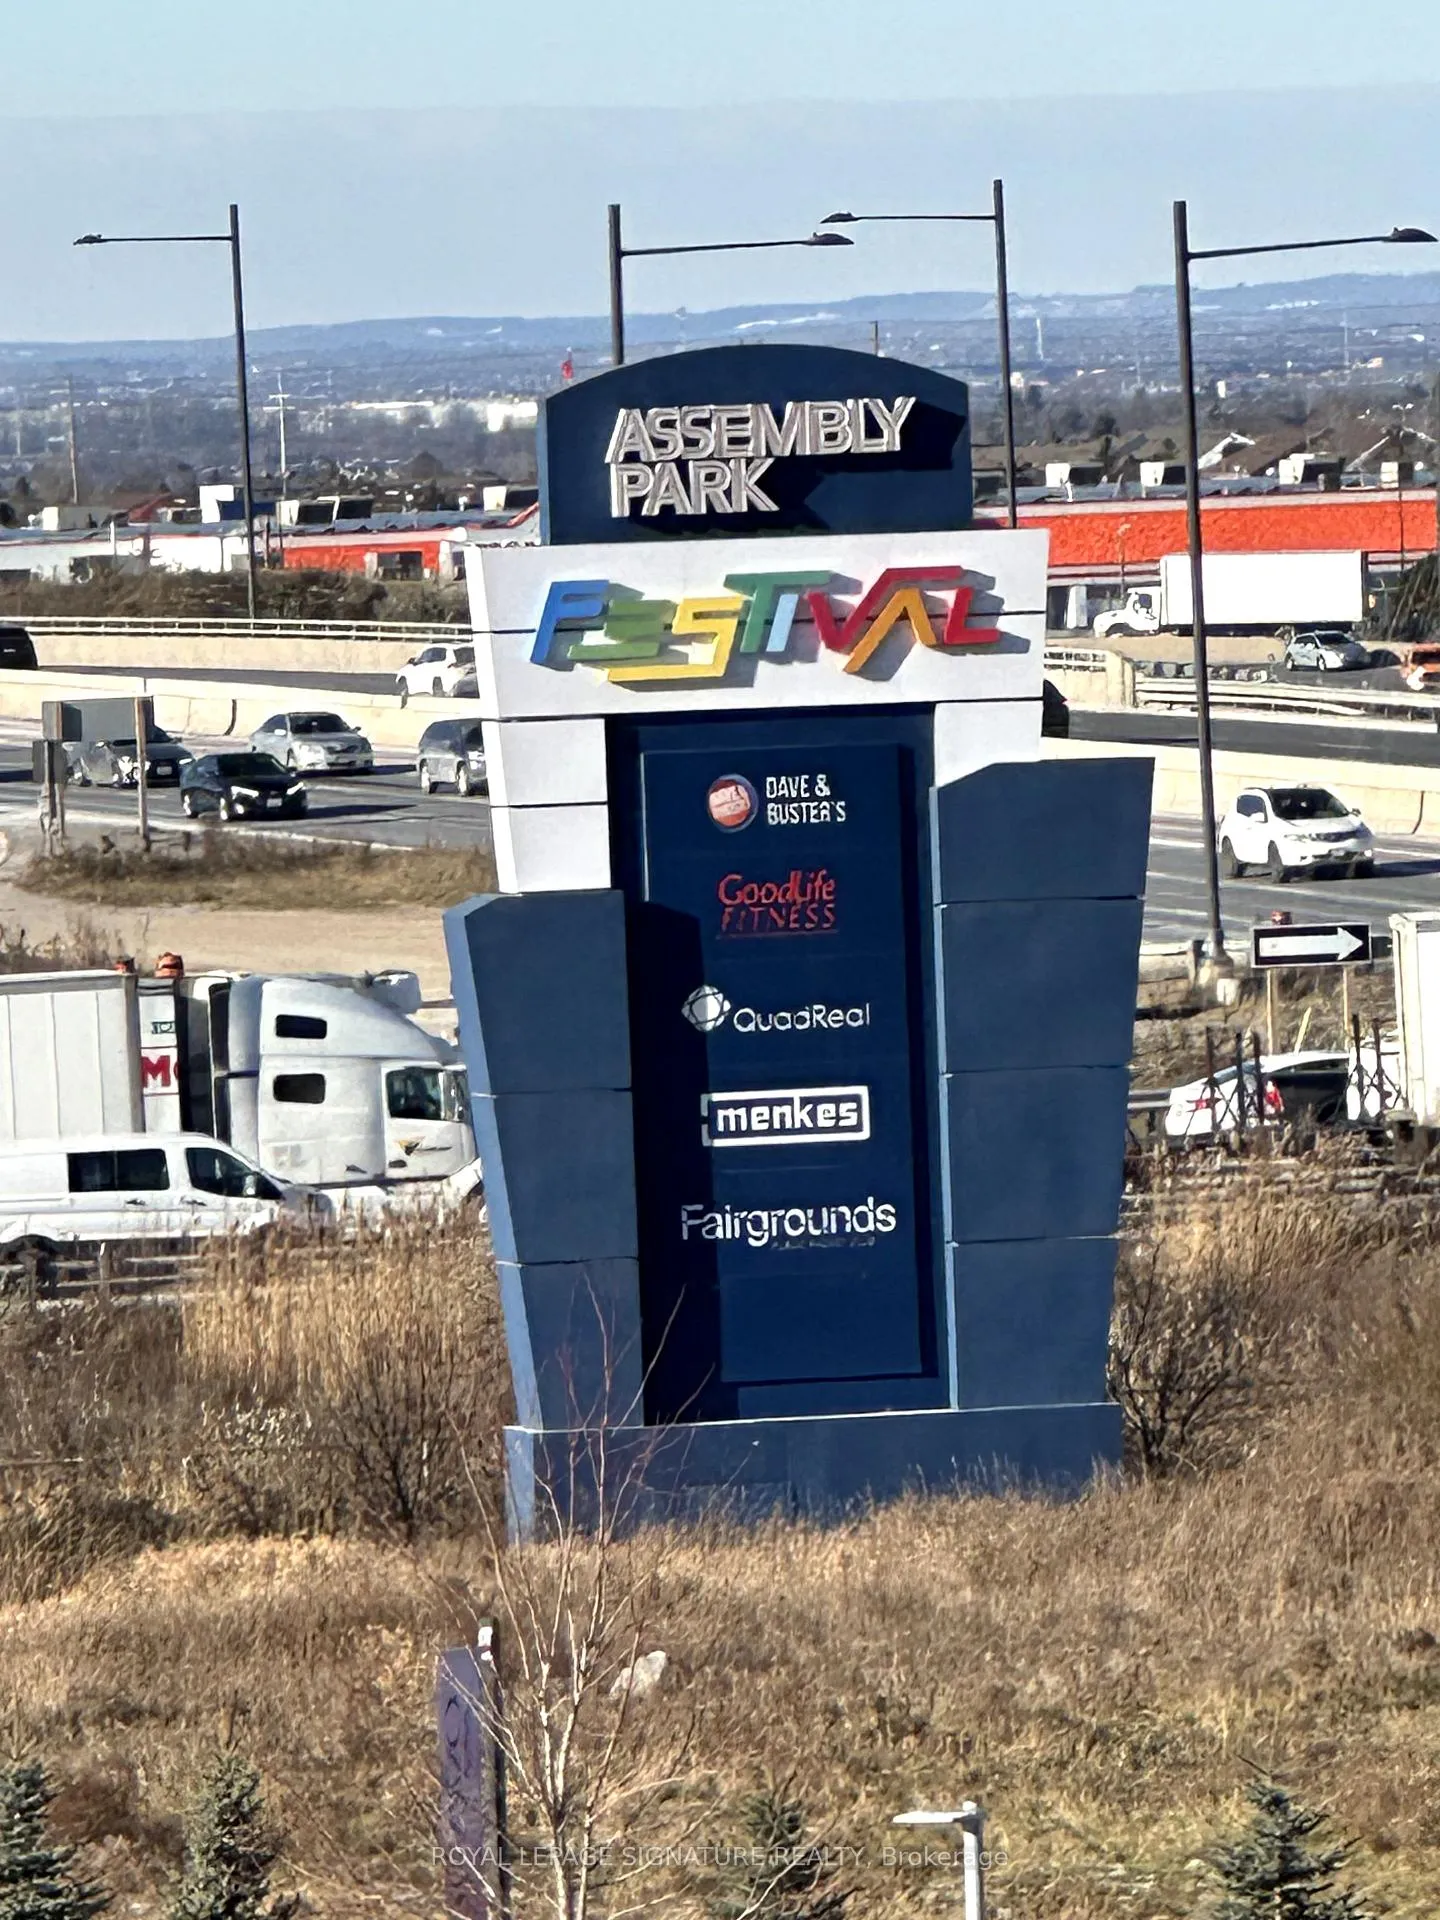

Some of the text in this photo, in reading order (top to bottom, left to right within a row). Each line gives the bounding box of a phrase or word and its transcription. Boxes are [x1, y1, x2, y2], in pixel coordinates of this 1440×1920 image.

[604, 397, 916, 463] ASSEMBLY
[610, 457, 779, 518] PARK
[530, 566, 999, 683] FESTIVAL
[765, 774, 831, 799] DAVE &
[767, 801, 846, 825] BUSTER'S
[718, 869, 836, 905] GoodLife
[721, 903, 835, 931] FITNESS
[733, 1003, 870, 1032] QuadReal
[717, 1097, 858, 1132] menkes
[681, 1196, 897, 1247] Fairgrounds
